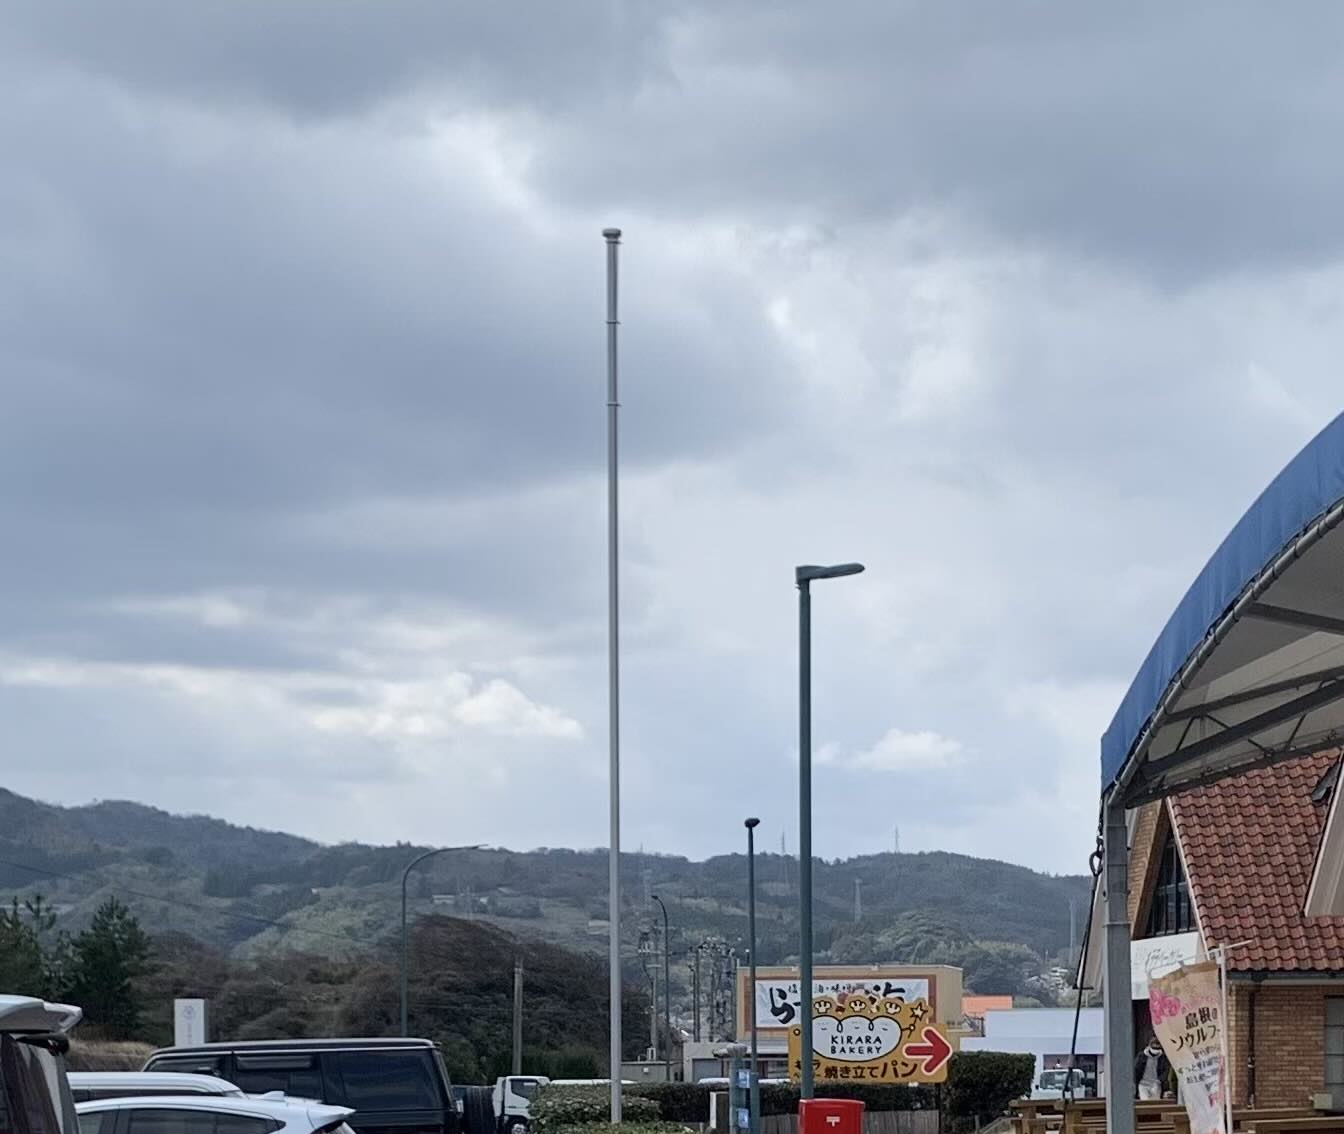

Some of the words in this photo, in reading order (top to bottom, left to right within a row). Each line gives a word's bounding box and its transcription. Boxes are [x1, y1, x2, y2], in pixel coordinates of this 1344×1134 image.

[831, 1035, 882, 1044] KIRARA
[830, 1046, 882, 1054] BAKERY
[824, 1060, 918, 1079] 焼き立てパン
